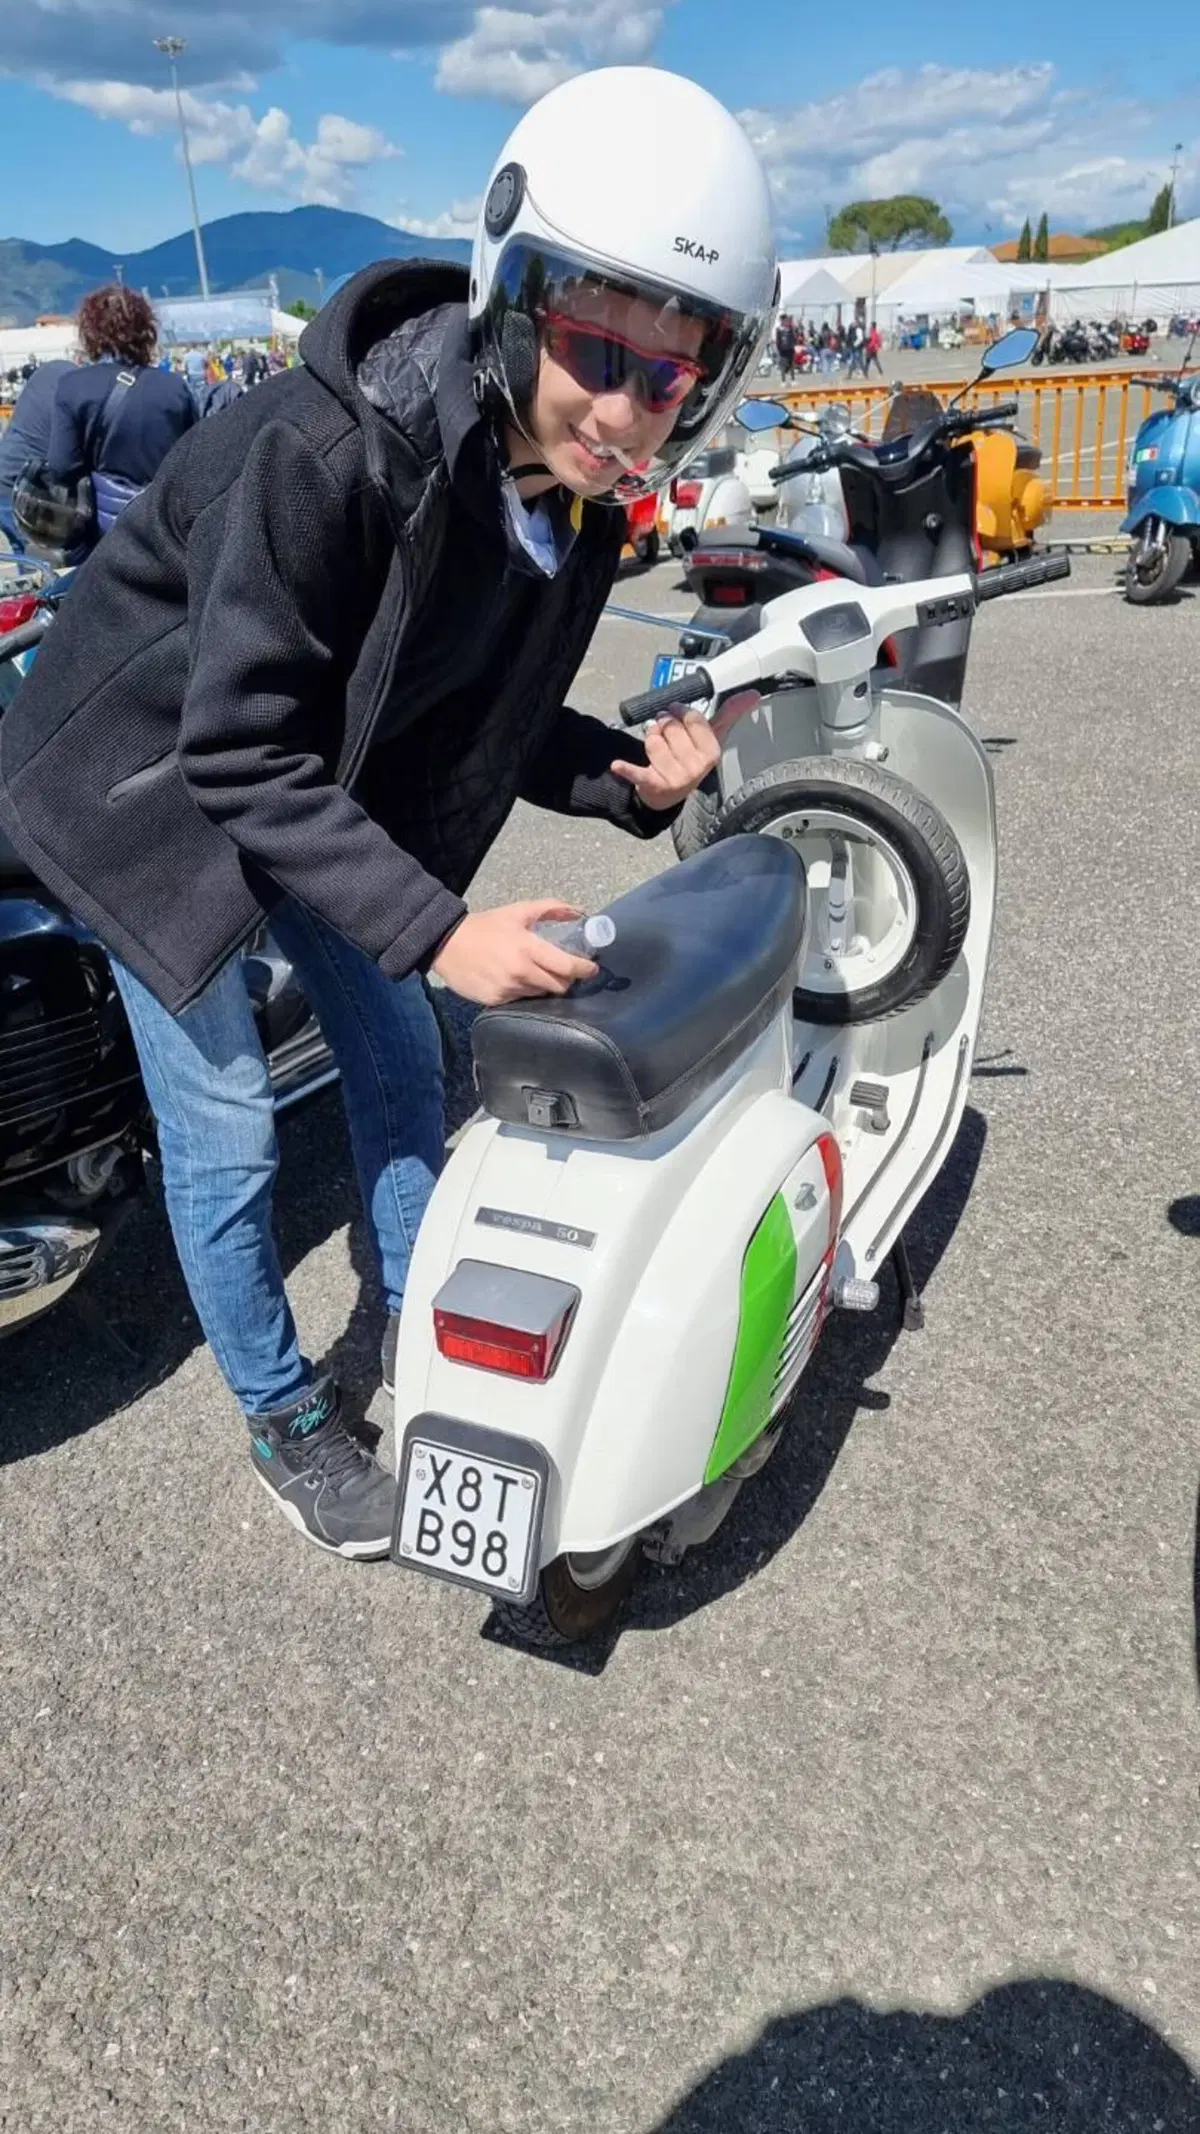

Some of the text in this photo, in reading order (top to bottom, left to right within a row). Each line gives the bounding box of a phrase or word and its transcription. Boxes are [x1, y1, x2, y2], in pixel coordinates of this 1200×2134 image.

[673, 236, 720, 265] SKA-P
[491, 1212, 579, 1242] vespa 50
[423, 1453, 519, 1522] X8T
[416, 1507, 508, 1577] B98
